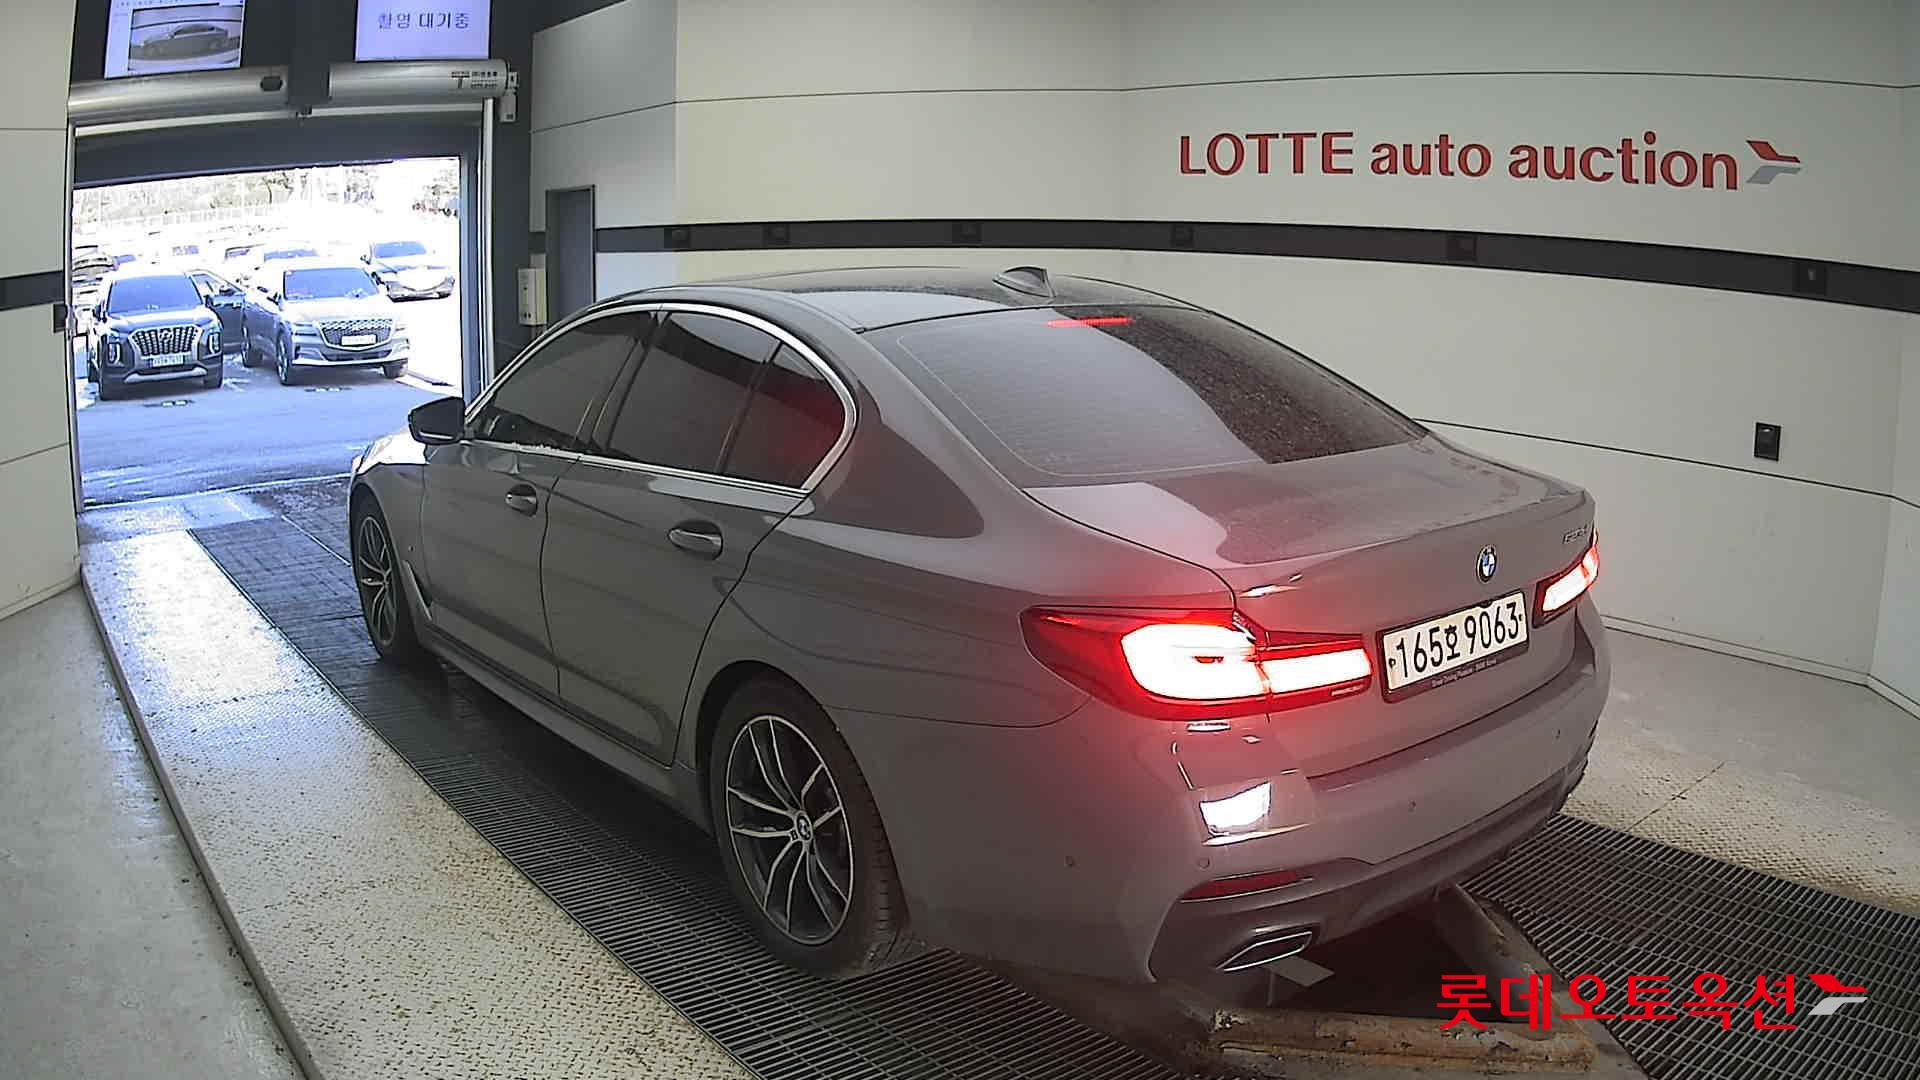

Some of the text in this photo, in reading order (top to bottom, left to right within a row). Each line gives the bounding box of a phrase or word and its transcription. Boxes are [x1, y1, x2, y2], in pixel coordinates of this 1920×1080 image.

[1179, 131, 1738, 190] LOTTE auto auction
